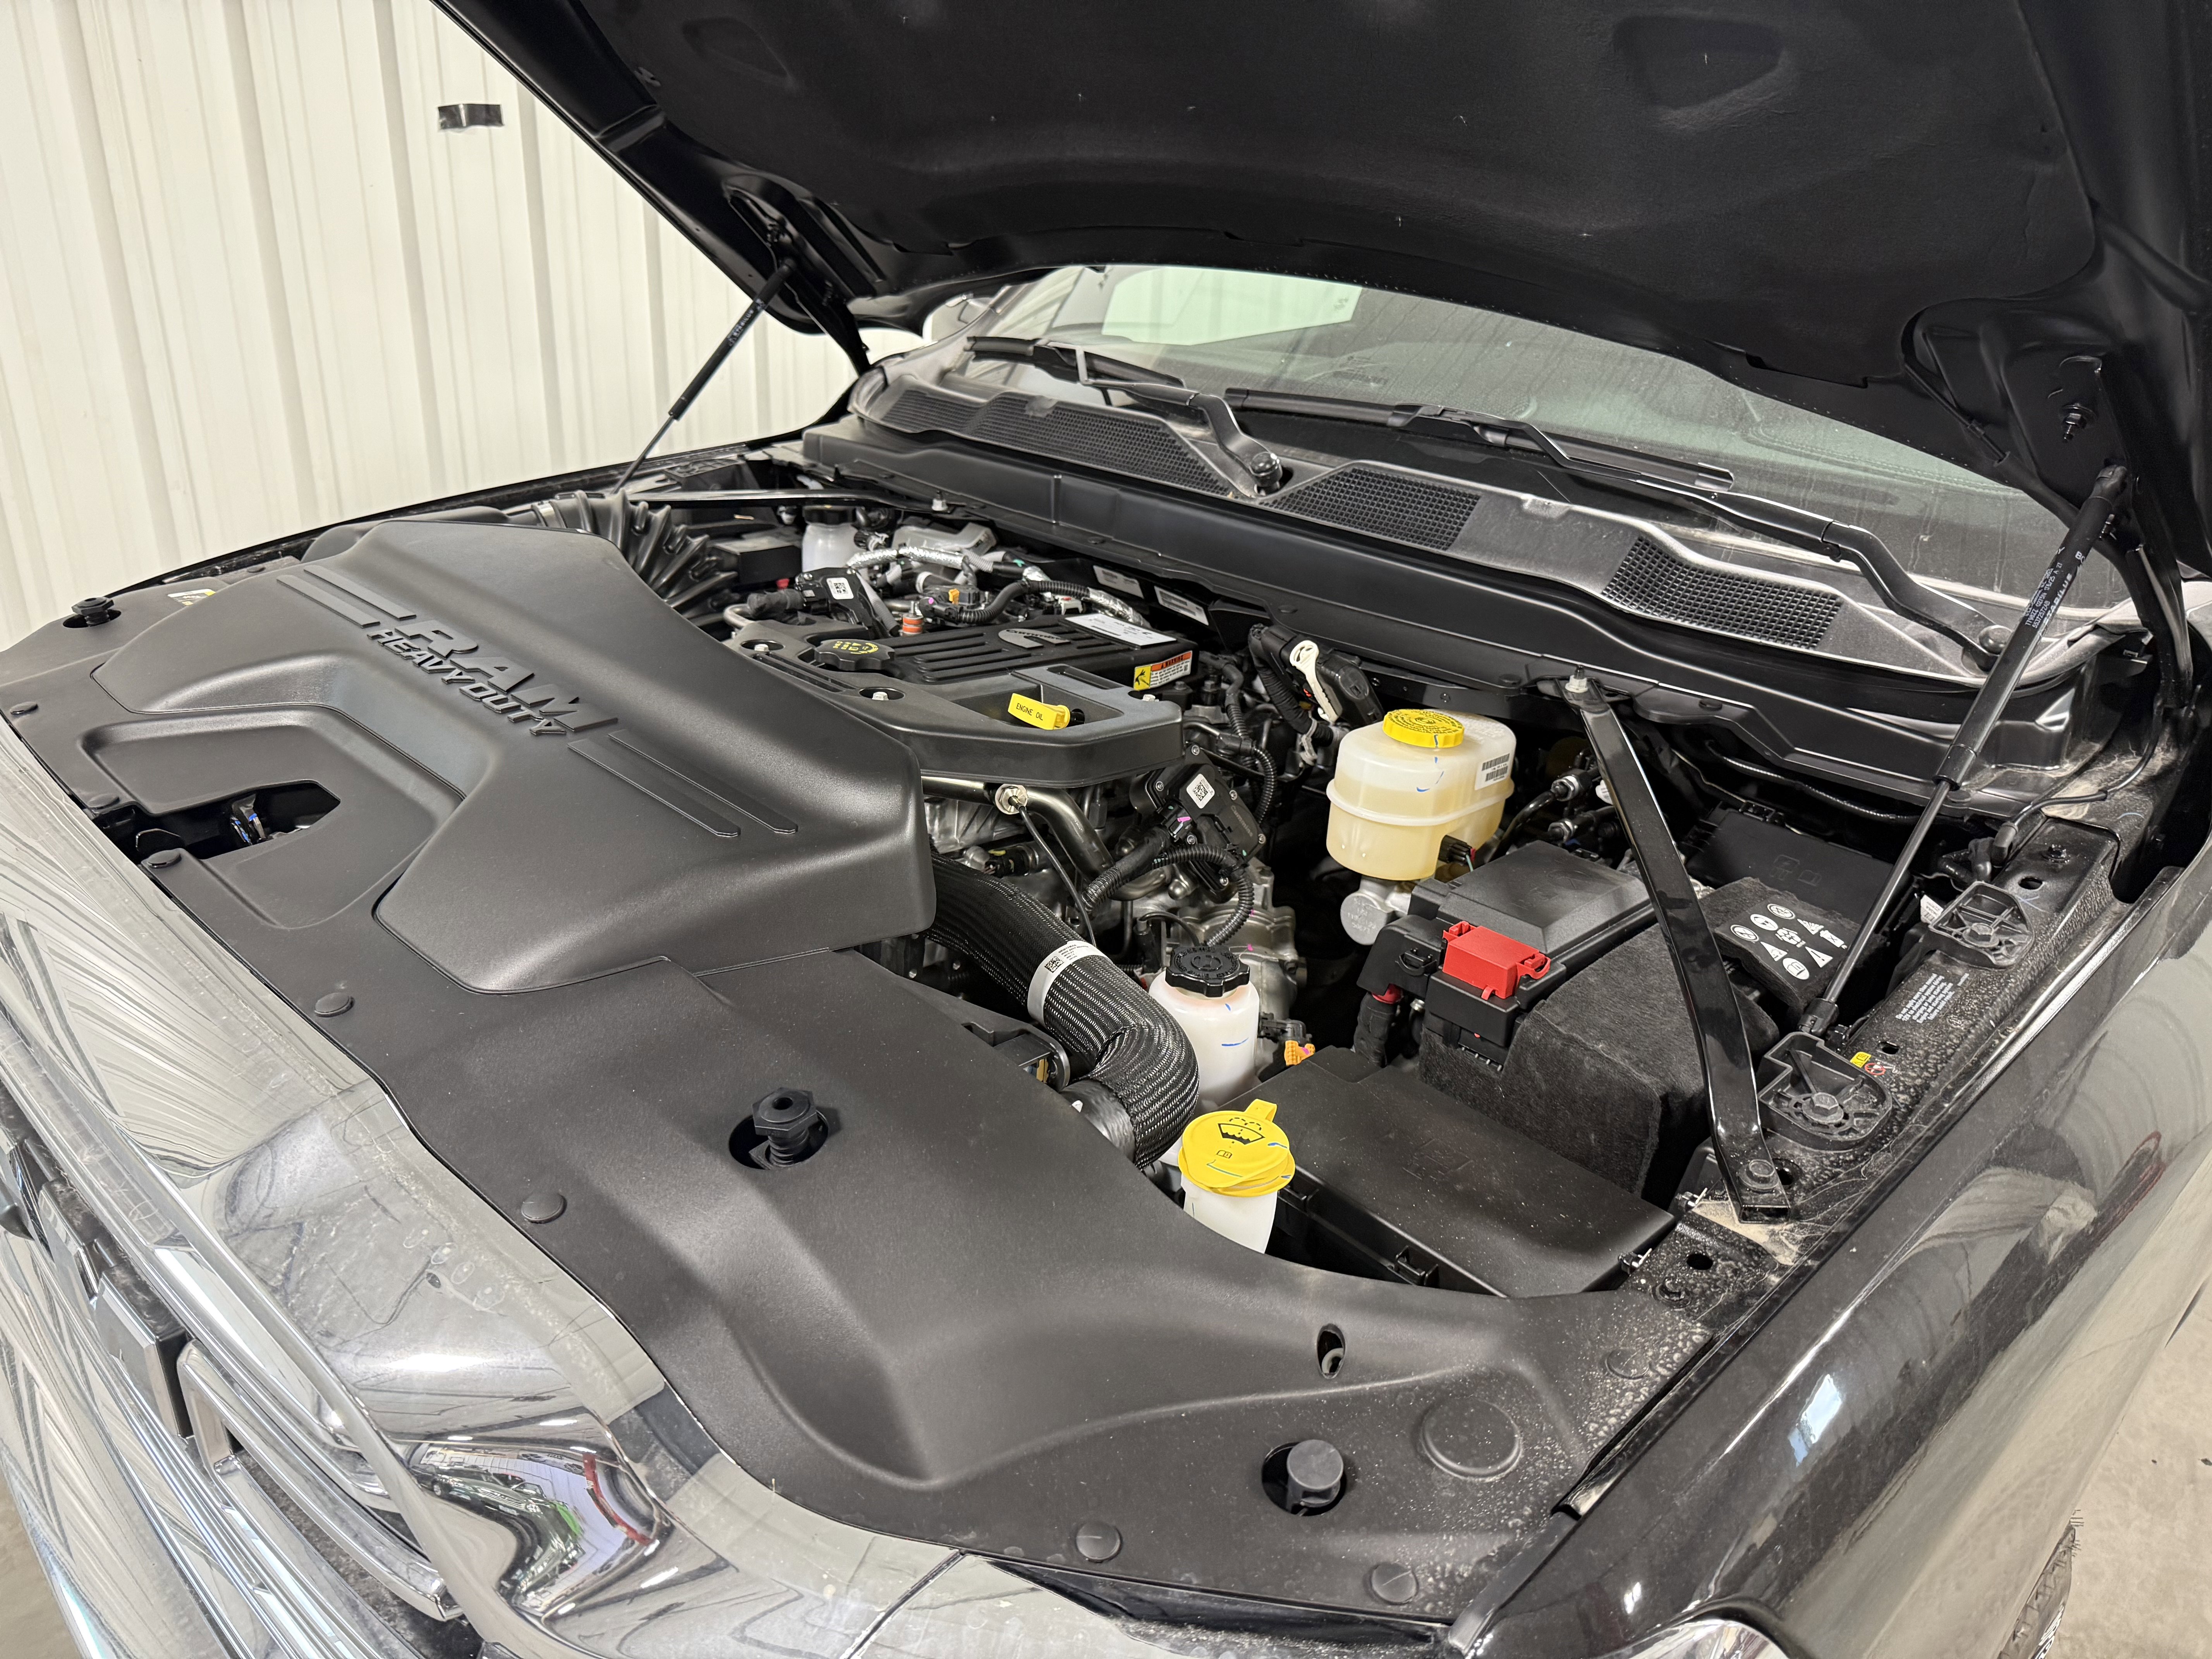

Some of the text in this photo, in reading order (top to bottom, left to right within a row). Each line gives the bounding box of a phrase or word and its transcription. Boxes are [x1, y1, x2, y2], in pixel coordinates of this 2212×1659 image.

[2043, 573, 2072, 625] STABILUS
[367, 629, 567, 735] HEAVY DUTY
[395, 620, 618, 732] RAM
[1016, 703, 1033, 716] ENGINE
